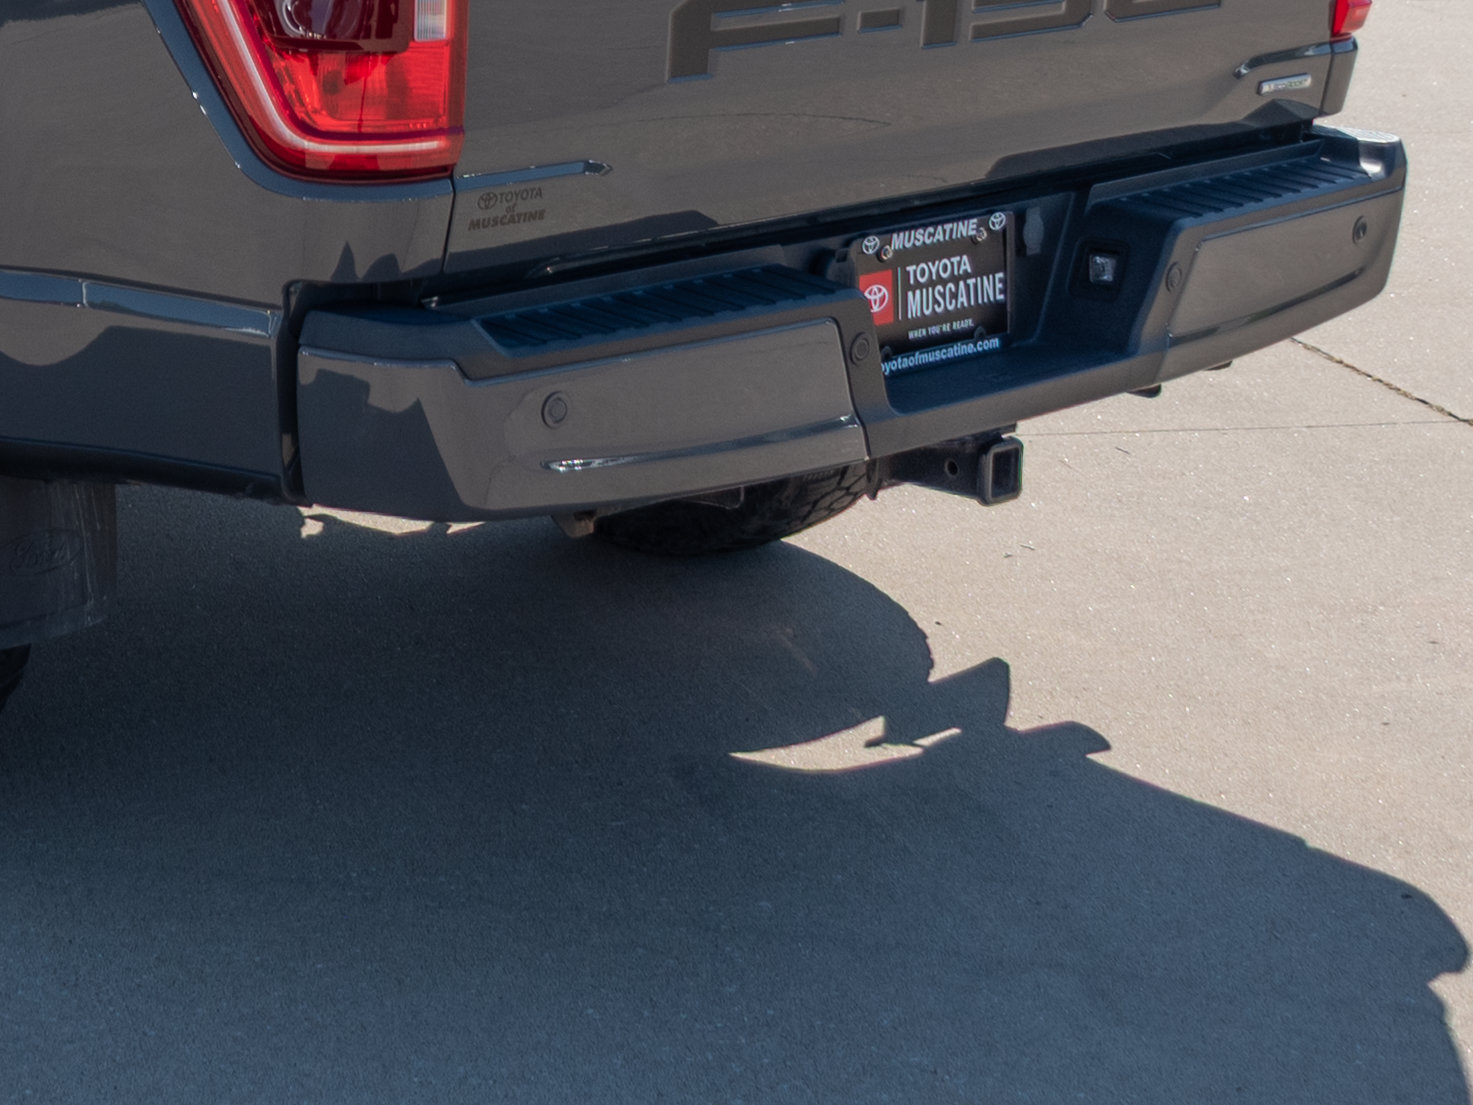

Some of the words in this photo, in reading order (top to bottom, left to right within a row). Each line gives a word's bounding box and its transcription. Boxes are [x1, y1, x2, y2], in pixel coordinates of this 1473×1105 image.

[498, 187, 543, 203] TOYOTA
[468, 209, 546, 231] MUSCATINE
[891, 218, 978, 250] MUSCATINE
[906, 254, 971, 285] TOYOTA
[907, 272, 1006, 320] MUSCATINE
[908, 328, 927, 340] WHEN
[928, 322, 951, 336] YOU'RE
